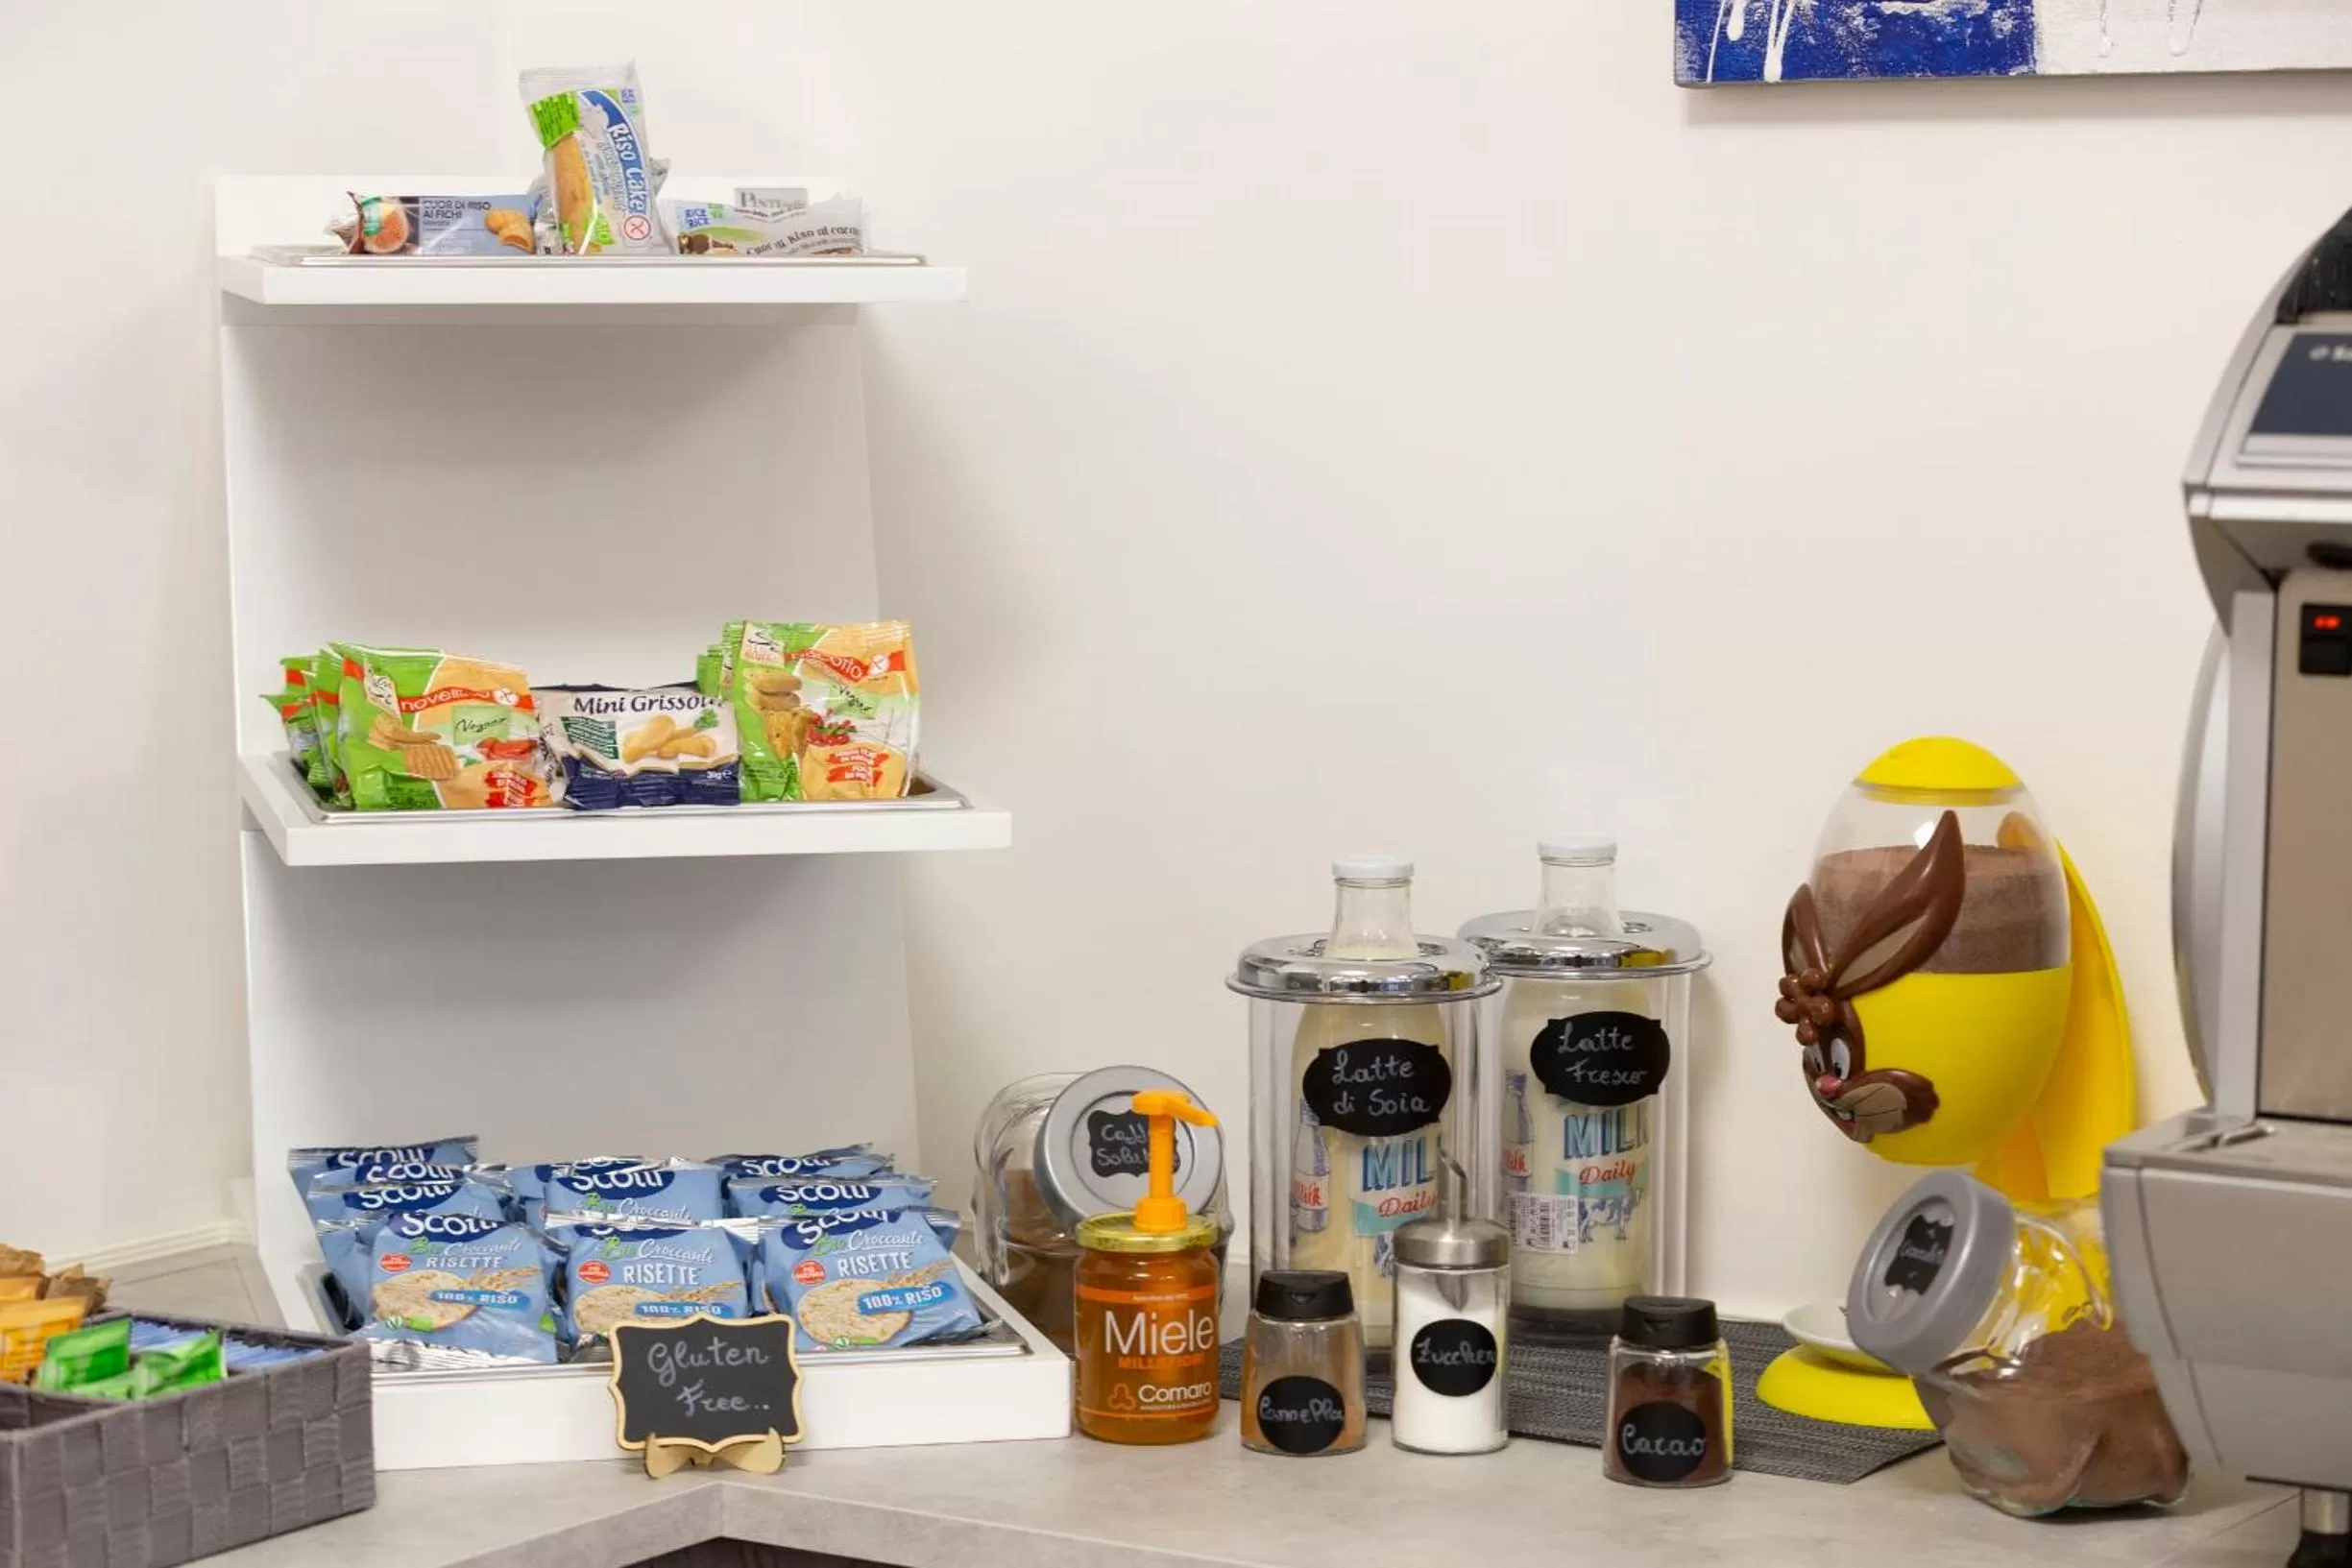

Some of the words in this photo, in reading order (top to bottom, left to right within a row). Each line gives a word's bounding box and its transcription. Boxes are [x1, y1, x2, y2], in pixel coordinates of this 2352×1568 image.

[574, 696, 626, 715] Mini
[1557, 1021, 1635, 1054] Latte
[1332, 1049, 1416, 1084] Latte
[1333, 1090, 1355, 1115] di
[1368, 1088, 1431, 1117] Soia
[1101, 1122, 1149, 1146] Caff
[1362, 1135, 1439, 1193] MIL
[1578, 1159, 1637, 1186] Daily
[425, 1256, 504, 1269] RISETTE
[623, 1263, 701, 1286] RISETTE
[837, 1251, 914, 1278] RISETTE
[862, 1293, 904, 1311] 100%
[904, 1285, 943, 1306] RISO
[1104, 1308, 1215, 1356] Miele
[646, 1335, 770, 1388] Gluten
[1620, 1422, 1706, 1456] Cacao
